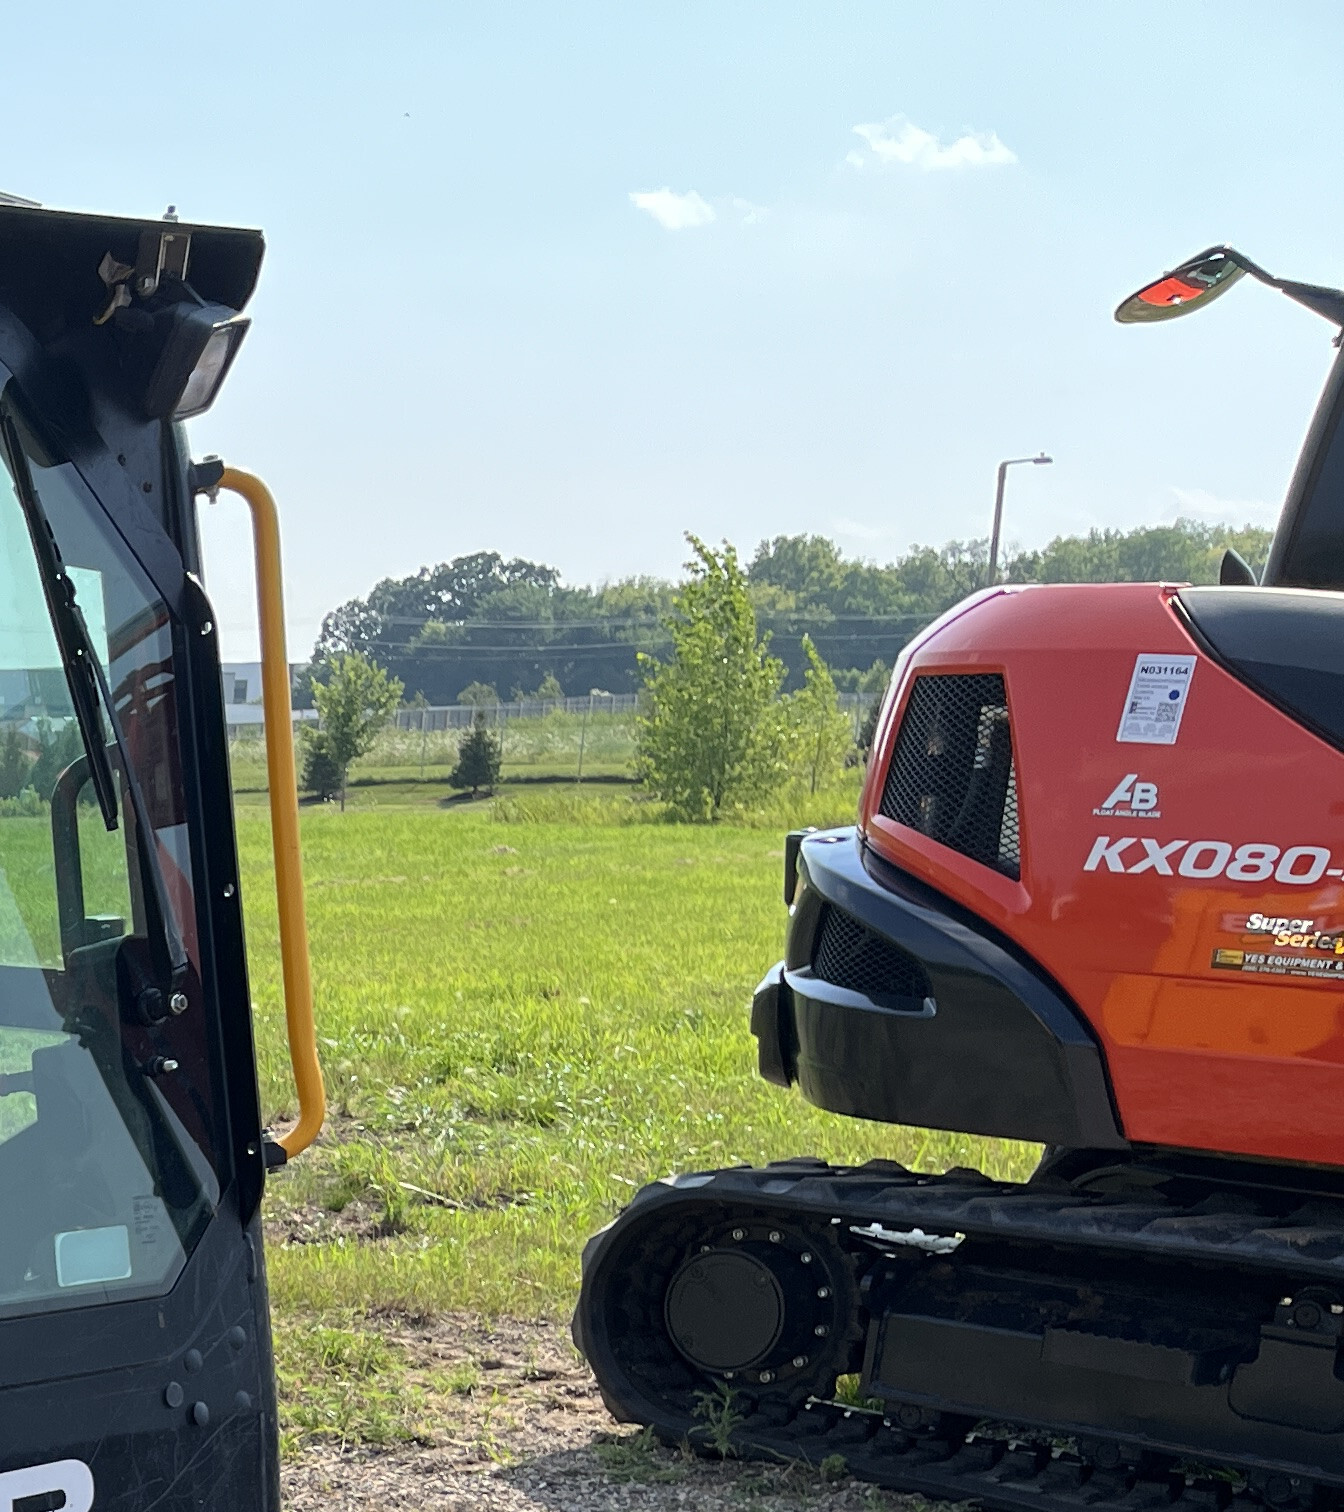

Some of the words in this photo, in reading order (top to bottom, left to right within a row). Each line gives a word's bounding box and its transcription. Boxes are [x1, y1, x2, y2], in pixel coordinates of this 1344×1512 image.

[1141, 666, 1189, 675] N031164
[1083, 836, 1344, 884] KX080-
[1246, 913, 1314, 935] Super
[1245, 953, 1266, 964] YES
[1266, 955, 1334, 970] EQUIPMENT
